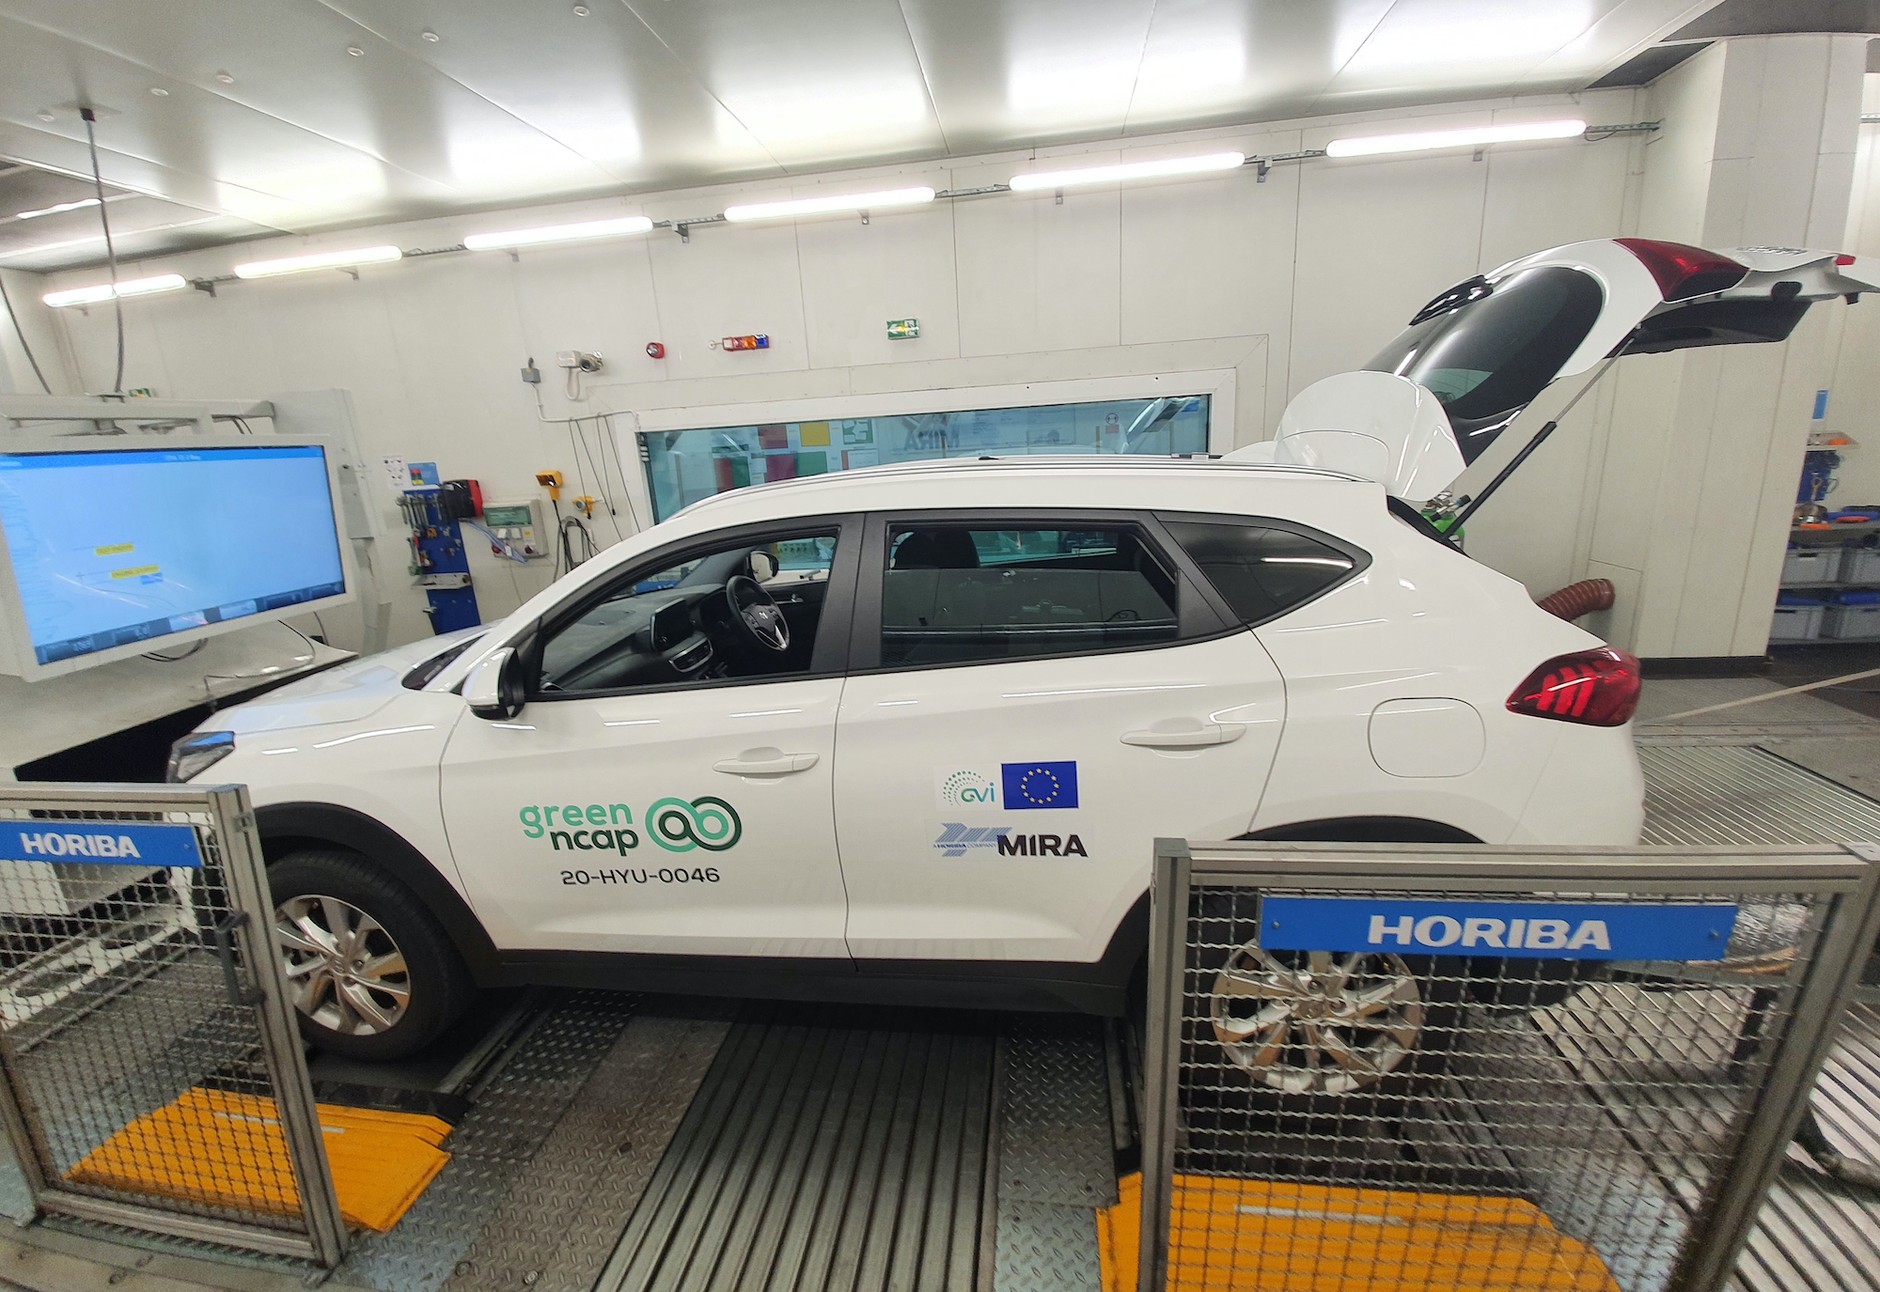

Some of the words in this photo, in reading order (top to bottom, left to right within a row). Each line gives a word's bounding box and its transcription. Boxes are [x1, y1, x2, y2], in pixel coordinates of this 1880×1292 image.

[519, 803, 633, 838] green
[19, 832, 141, 858] HORIBA
[550, 829, 639, 856] ncap
[997, 834, 1088, 857] MIRA
[560, 867, 720, 885] 20-HYU-0046
[1367, 914, 1612, 950] HORIBA
